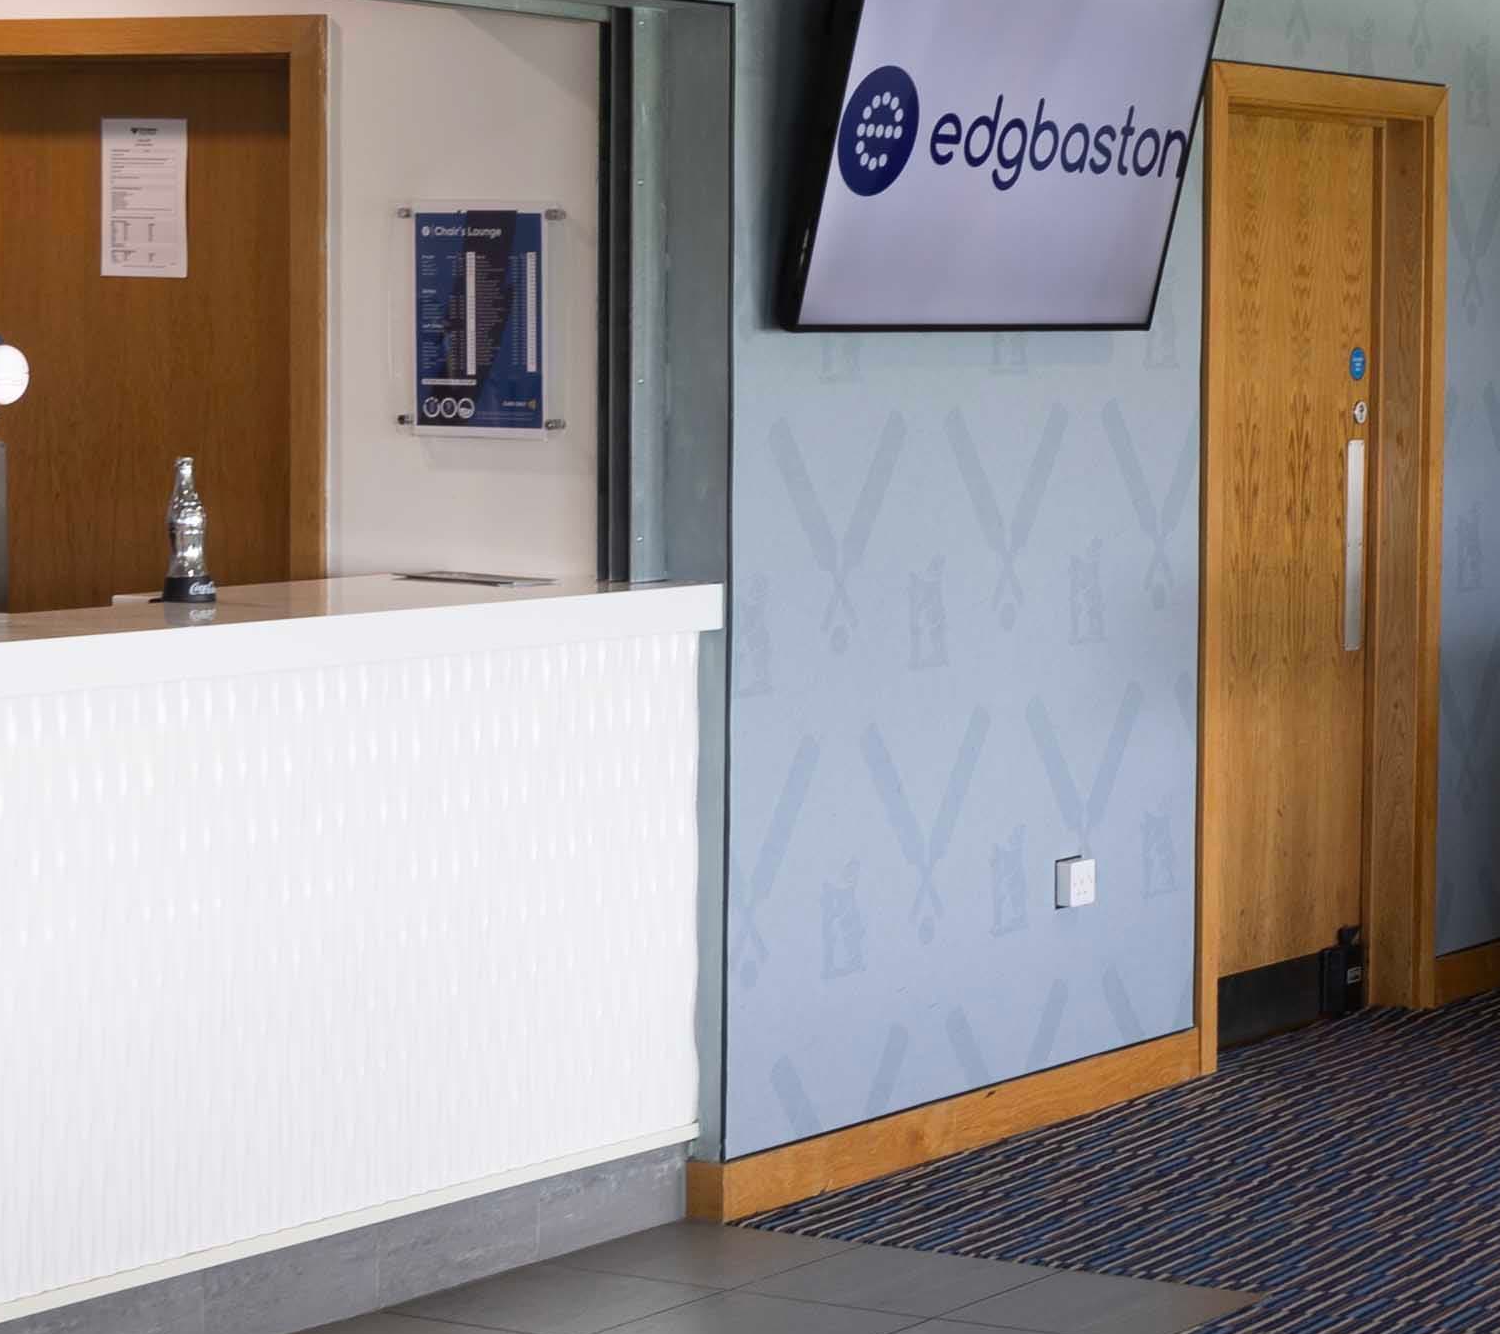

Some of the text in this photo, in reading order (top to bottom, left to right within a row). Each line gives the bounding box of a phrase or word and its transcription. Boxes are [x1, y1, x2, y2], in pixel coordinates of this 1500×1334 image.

[929, 93, 1188, 192] edgbaston
[434, 226, 502, 239] Chair's Lounge
